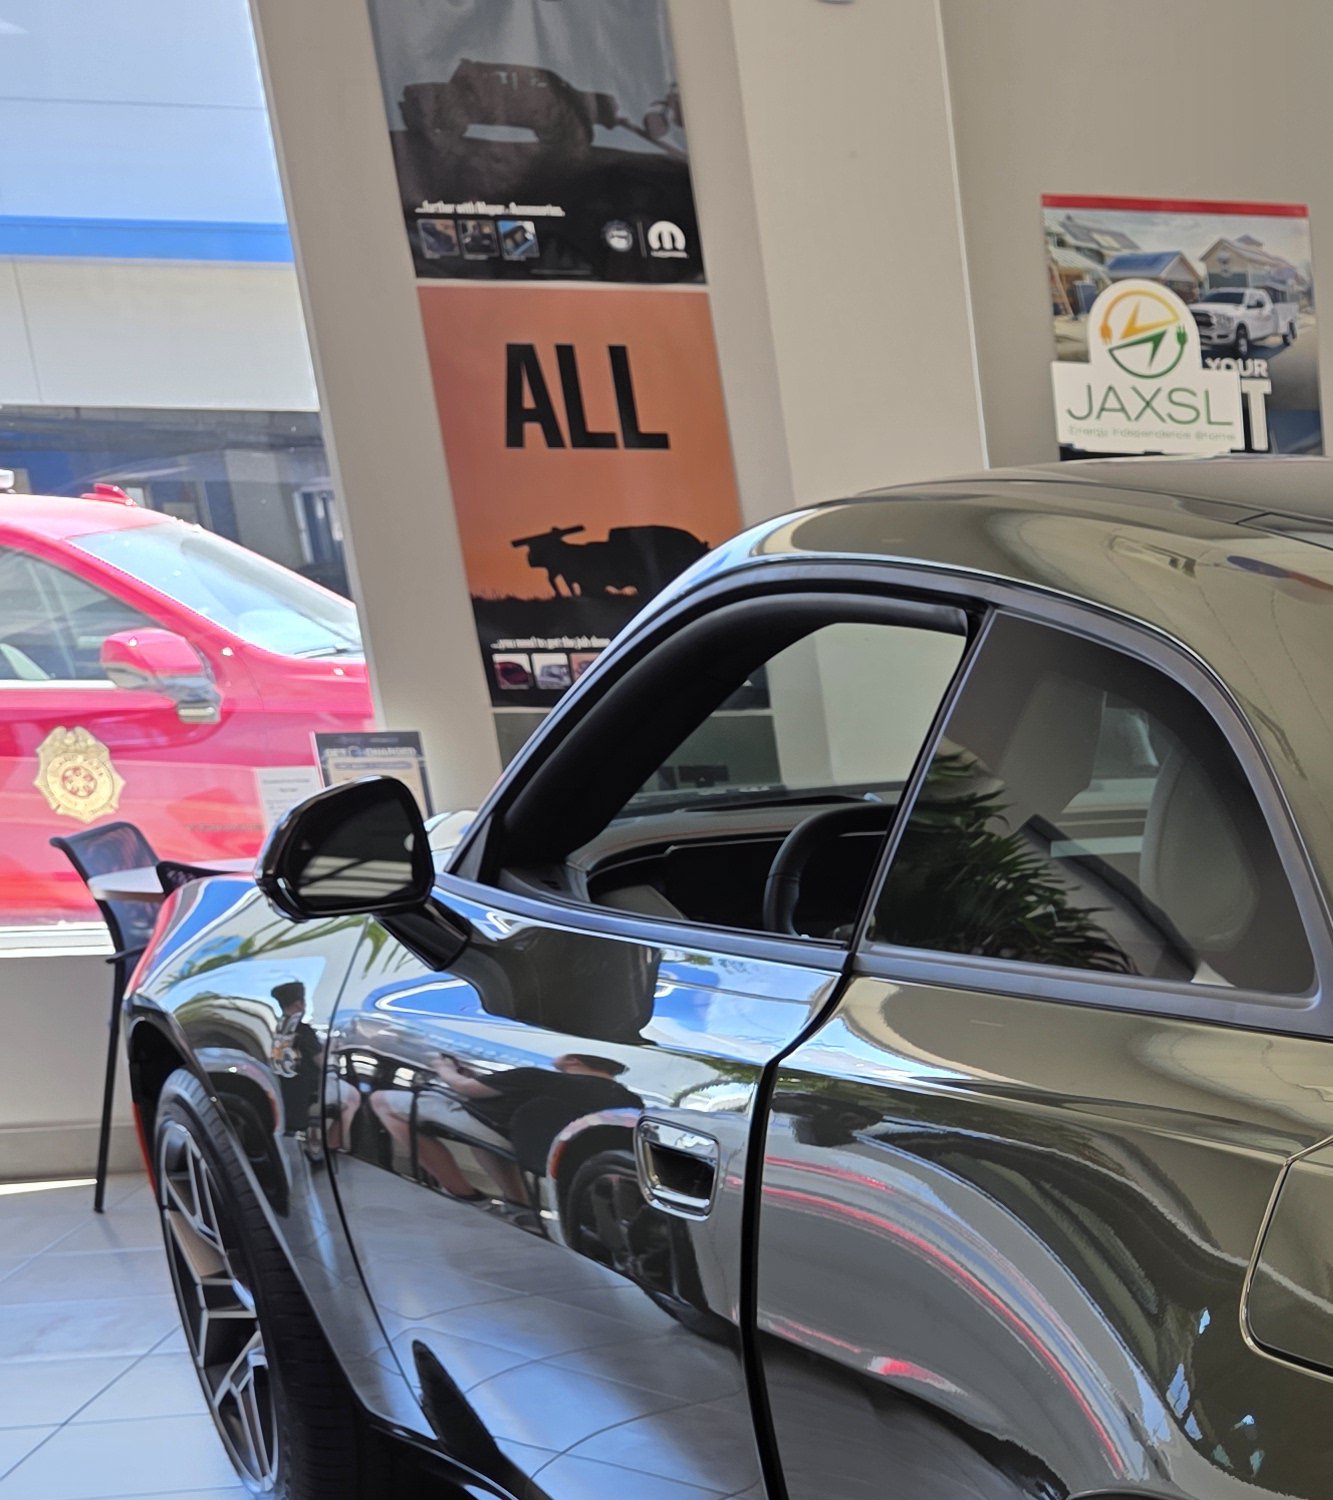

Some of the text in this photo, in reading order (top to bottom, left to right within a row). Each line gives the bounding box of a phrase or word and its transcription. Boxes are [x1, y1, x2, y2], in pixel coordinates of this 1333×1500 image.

[1205, 357, 1268, 377] YOUR
[506, 344, 670, 449] ALL
[1067, 383, 1234, 425] JAXSL
